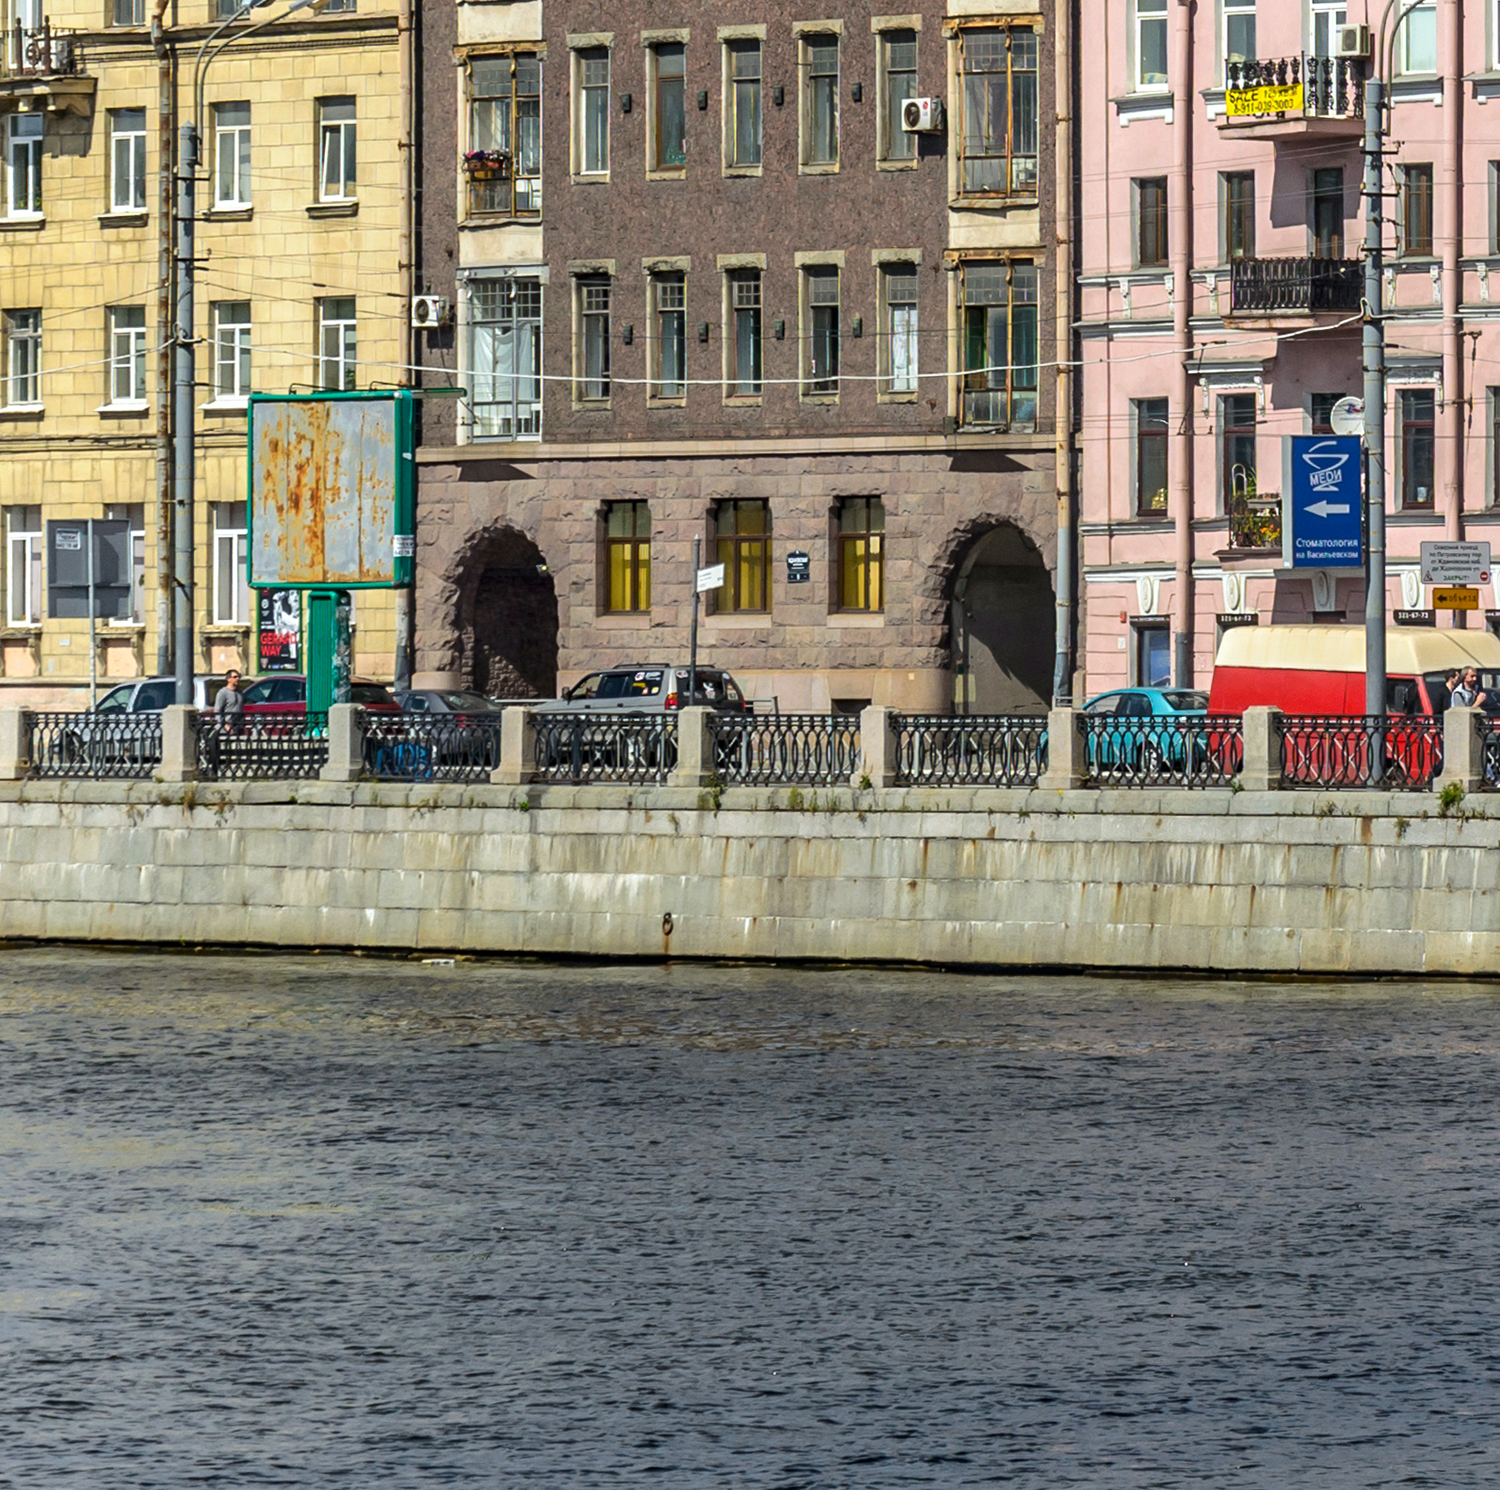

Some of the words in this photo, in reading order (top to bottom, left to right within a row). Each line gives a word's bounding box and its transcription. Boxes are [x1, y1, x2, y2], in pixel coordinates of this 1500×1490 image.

[1229, 88, 1258, 103] SALE
[1296, 538, 1358, 548] Стоматология
[1307, 551, 1358, 559] Васильевском
[260, 633, 297, 644] GERARD
[260, 646, 282, 657] WAY
